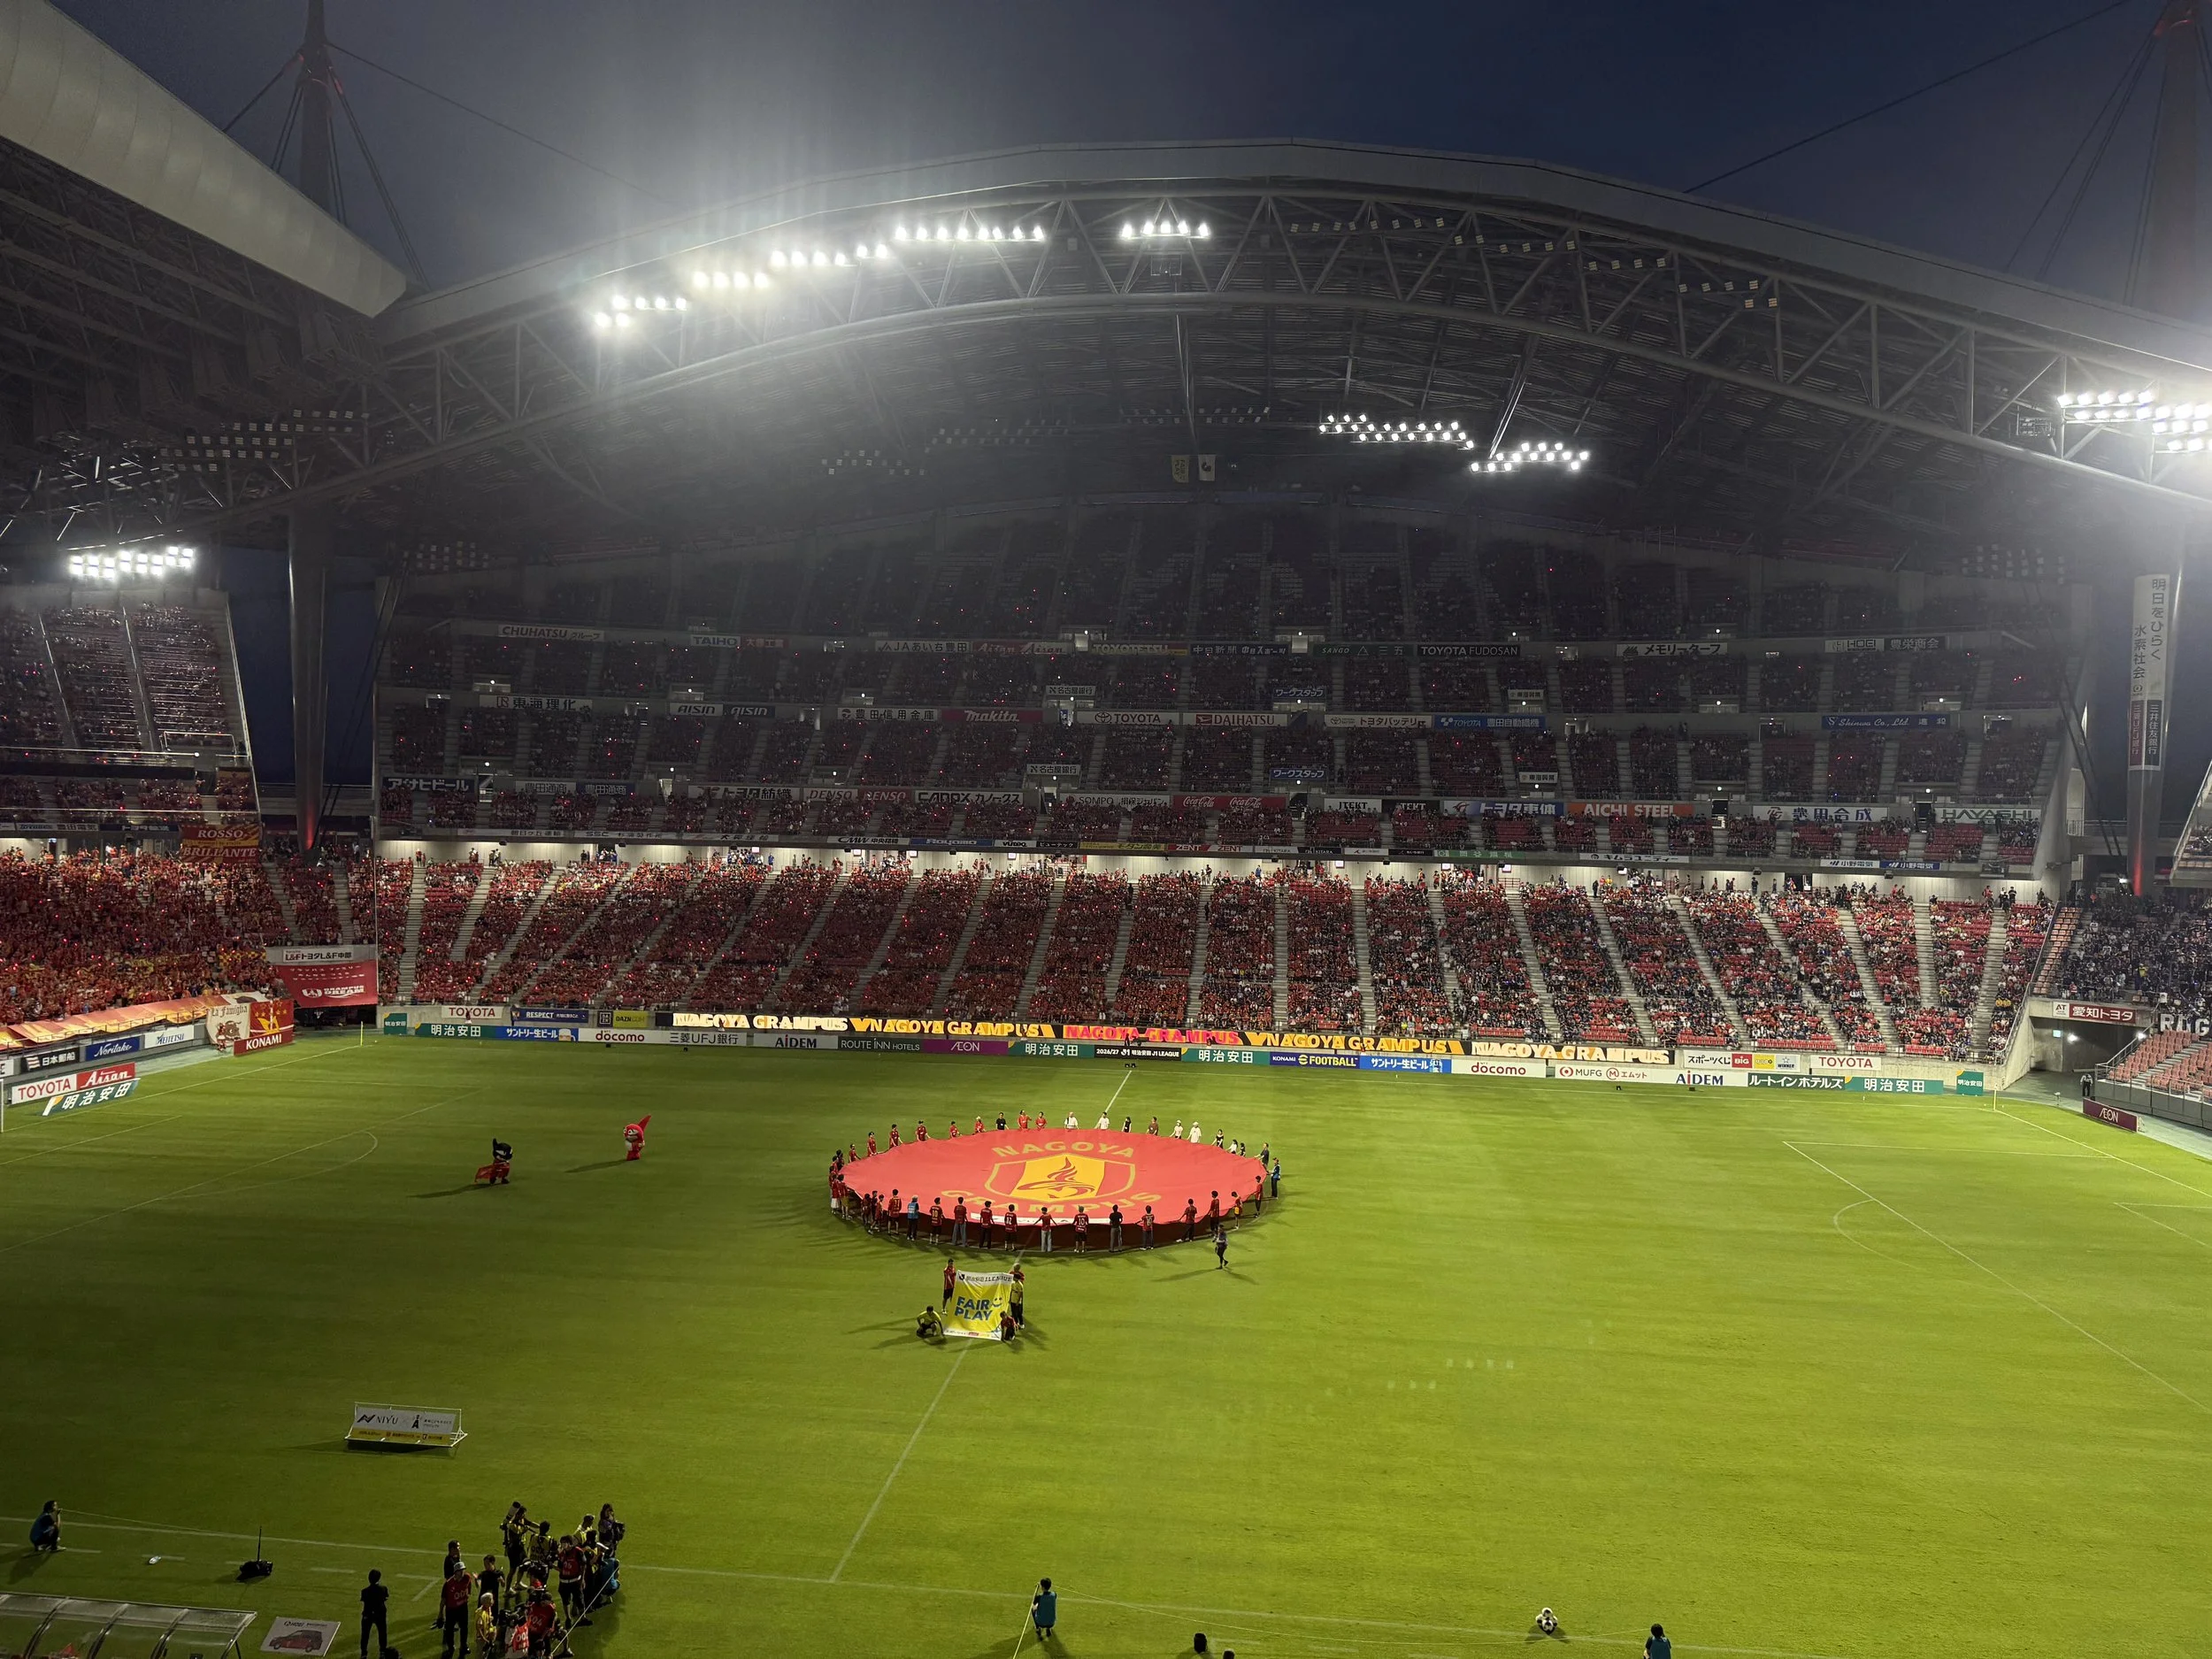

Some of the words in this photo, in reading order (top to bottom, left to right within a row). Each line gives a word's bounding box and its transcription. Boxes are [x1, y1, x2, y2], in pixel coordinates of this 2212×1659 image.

[2150, 578, 2166, 661] 明日をひらく
[503, 626, 567, 638] CHUHATSU
[695, 636, 737, 646] TAIHO
[1022, 642, 1065, 655] Aisan
[1093, 644, 1168, 655] TOYOTETSU
[1379, 646, 1403, 656] 三五
[1421, 646, 1467, 656] TOYOTA
[1469, 647, 1517, 656] FUDOSAN
[1644, 643, 1721, 655] メモリーターフ
[2132, 624, 2147, 680] 水素社会
[513, 696, 576, 710] 東海理化
[678, 705, 715, 715] AISIN
[856, 709, 934, 721] 豊田信用金庫
[1114, 713, 1161, 723] TOYOTA
[1214, 715, 1274, 726] DAIHATSU
[1040, 765, 1077, 774] 名古屋銀行
[388, 778, 469, 791] アサヒビール
[810, 790, 852, 800] DENSO
[975, 794, 1020, 803] カノークス
[1079, 796, 1113, 805] SOMPO
[1339, 802, 1368, 810] JTEKT
[1479, 803, 1555, 815] トヨタ車体
[1584, 803, 1627, 817] AICHI
[1634, 804, 1677, 818] STEEL
[1942, 810, 2032, 819] HAYASHI
[197, 829, 243, 838] ROSSO
[183, 847, 257, 857] BRILLANTE
[449, 1007, 495, 1018] TOYOTA
[2072, 1006, 2133, 1021] 愛知トヨタ
[753, 1015, 848, 1031] GRAMPUS
[870, 1018, 945, 1034] NAGOYA
[948, 1021, 1040, 1038] GRAMPUS
[431, 1025, 480, 1037] 明治安田
[506, 1027, 557, 1039] サントリー生ビール
[595, 1030, 645, 1042] docomo
[1064, 1025, 1140, 1040] NAGOYA
[1144, 1027, 1242, 1044] GRAMPUS
[246, 1033, 282, 1050] KONAMI
[670, 1033, 739, 1045] 三菱UFJ銀行
[841, 1040, 872, 1049] ROUTE
[1267, 1033, 1345, 1049] NAGOYA
[1348, 1036, 1447, 1053] GRAMPUS
[94, 1042, 132, 1057] Noritake
[1025, 1043, 1078, 1056] 明治安田
[1471, 1041, 1557, 1059] NAGOYA
[1561, 1045, 1669, 1064] GRAMPUS
[42, 1051, 75, 1066] 日本郵船
[1198, 1049, 1253, 1064] 明治安田
[1688, 1055, 1731, 1065] スポーツくじ
[1819, 1056, 1873, 1068] TOYOTA
[1371, 1058, 1429, 1070] サントリー生ビール
[1471, 1062, 1526, 1075] docomo
[1576, 1068, 1602, 1077] MUFG
[81, 1069, 133, 1089] Aisan
[18, 1078, 72, 1100] TOYOTA
[1864, 1078, 1924, 1093] 明治安田
[62, 1081, 132, 1110] 明治安田
[991, 1141, 1135, 1158] NAGOYA
[941, 1189, 1162, 1213] GRAMPUS
[956, 1296, 991, 1310] FAIR
[955, 1306, 993, 1321] PLAY
